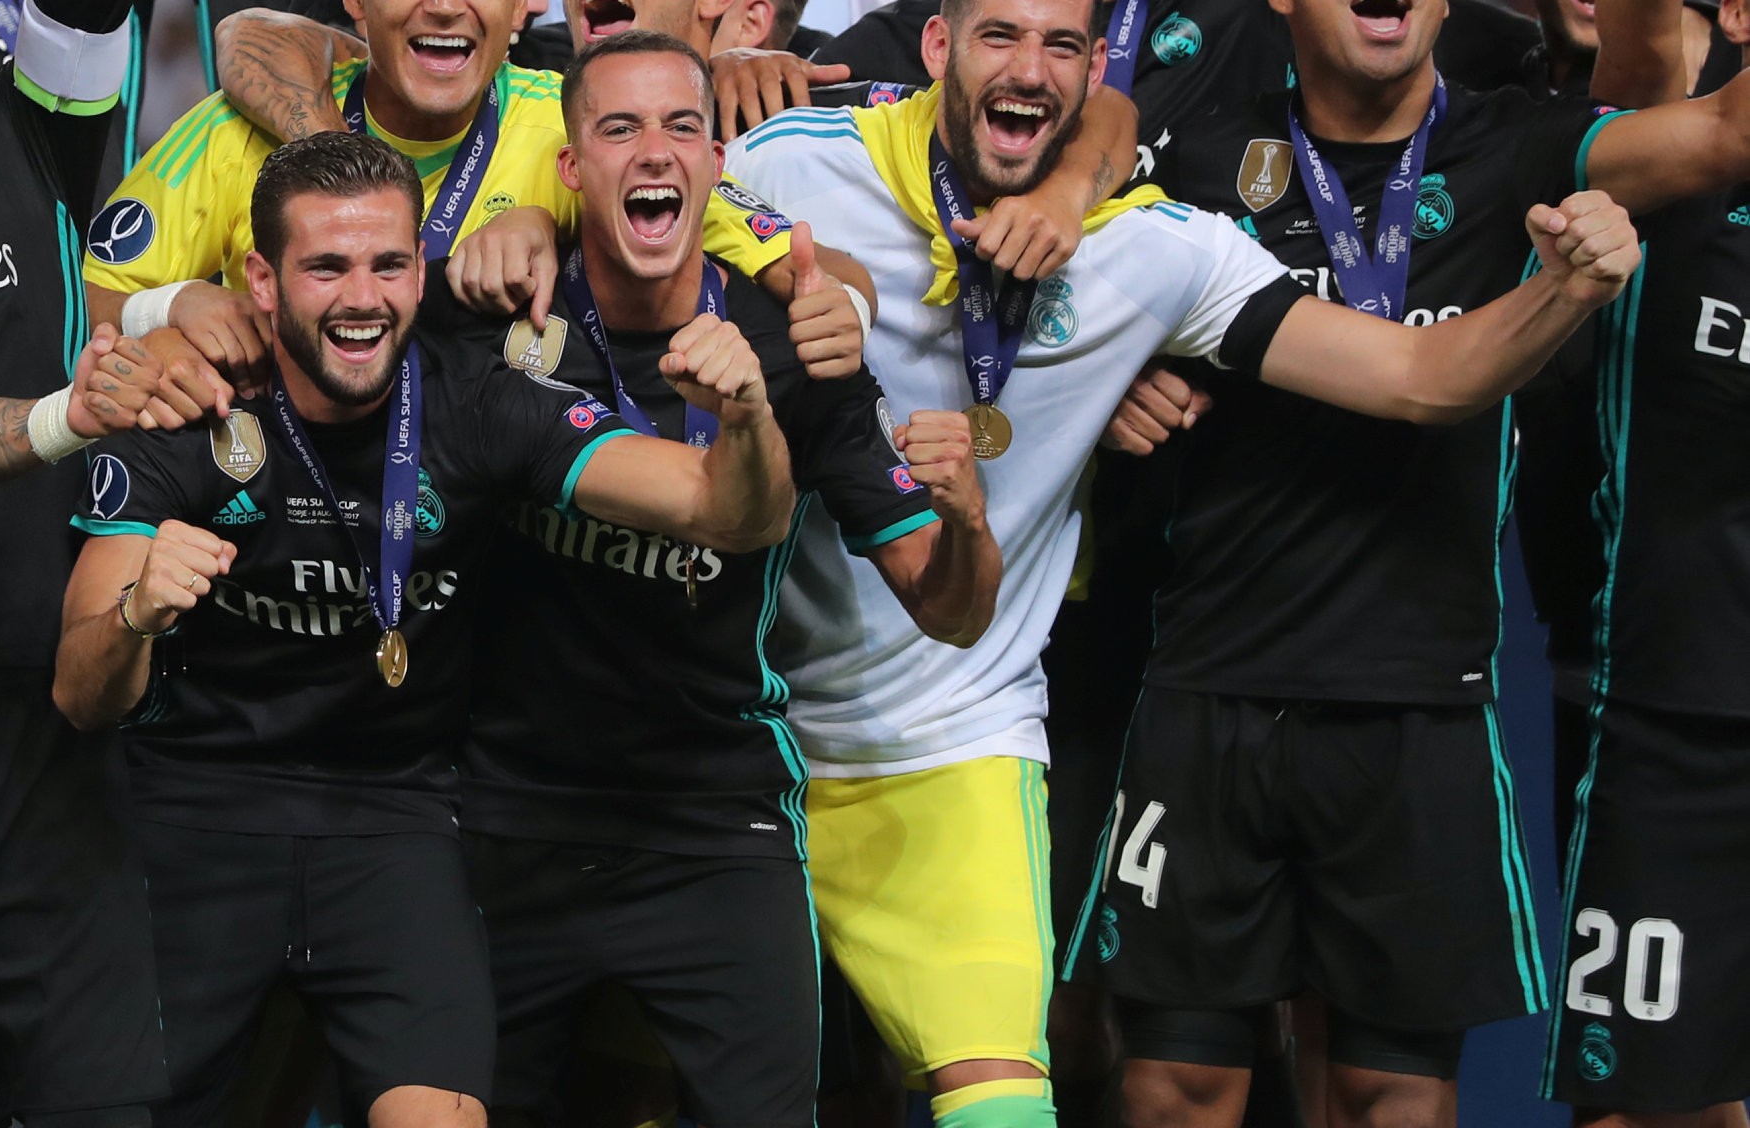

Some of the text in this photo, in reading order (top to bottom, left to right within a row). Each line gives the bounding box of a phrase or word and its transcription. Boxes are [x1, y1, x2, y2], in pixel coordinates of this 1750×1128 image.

[442, 131, 486, 219] UEFA SUPER CUP
[1307, 149, 1333, 204] SUPER CUP
[1400, 149, 1413, 175] UEFA
[939, 177, 954, 205] UEFA
[1250, 183, 1272, 193] FIFA
[1386, 224, 1400, 263] SKOPJE
[518, 354, 543, 368] FIFA
[400, 379, 410, 416] SUPER
[978, 371, 990, 400] UEFA
[279, 406, 324, 491] UEFA SUPER CUP
[399, 419, 409, 448] UEFA
[229, 454, 253, 464] FIFA
[212, 512, 266, 525] adidas
[286, 497, 308, 507] UEFA
[338, 501, 357, 510] CUP
[393, 500, 406, 540] SKOPJE
[405, 512, 413, 530] 2017
[517, 500, 722, 582] mirates
[291, 560, 369, 599] Fly
[214, 571, 458, 635] Emires
[392, 573, 402, 626] UPER CUP
[1103, 789, 1167, 909] 14
[1566, 907, 1684, 1022] 20
